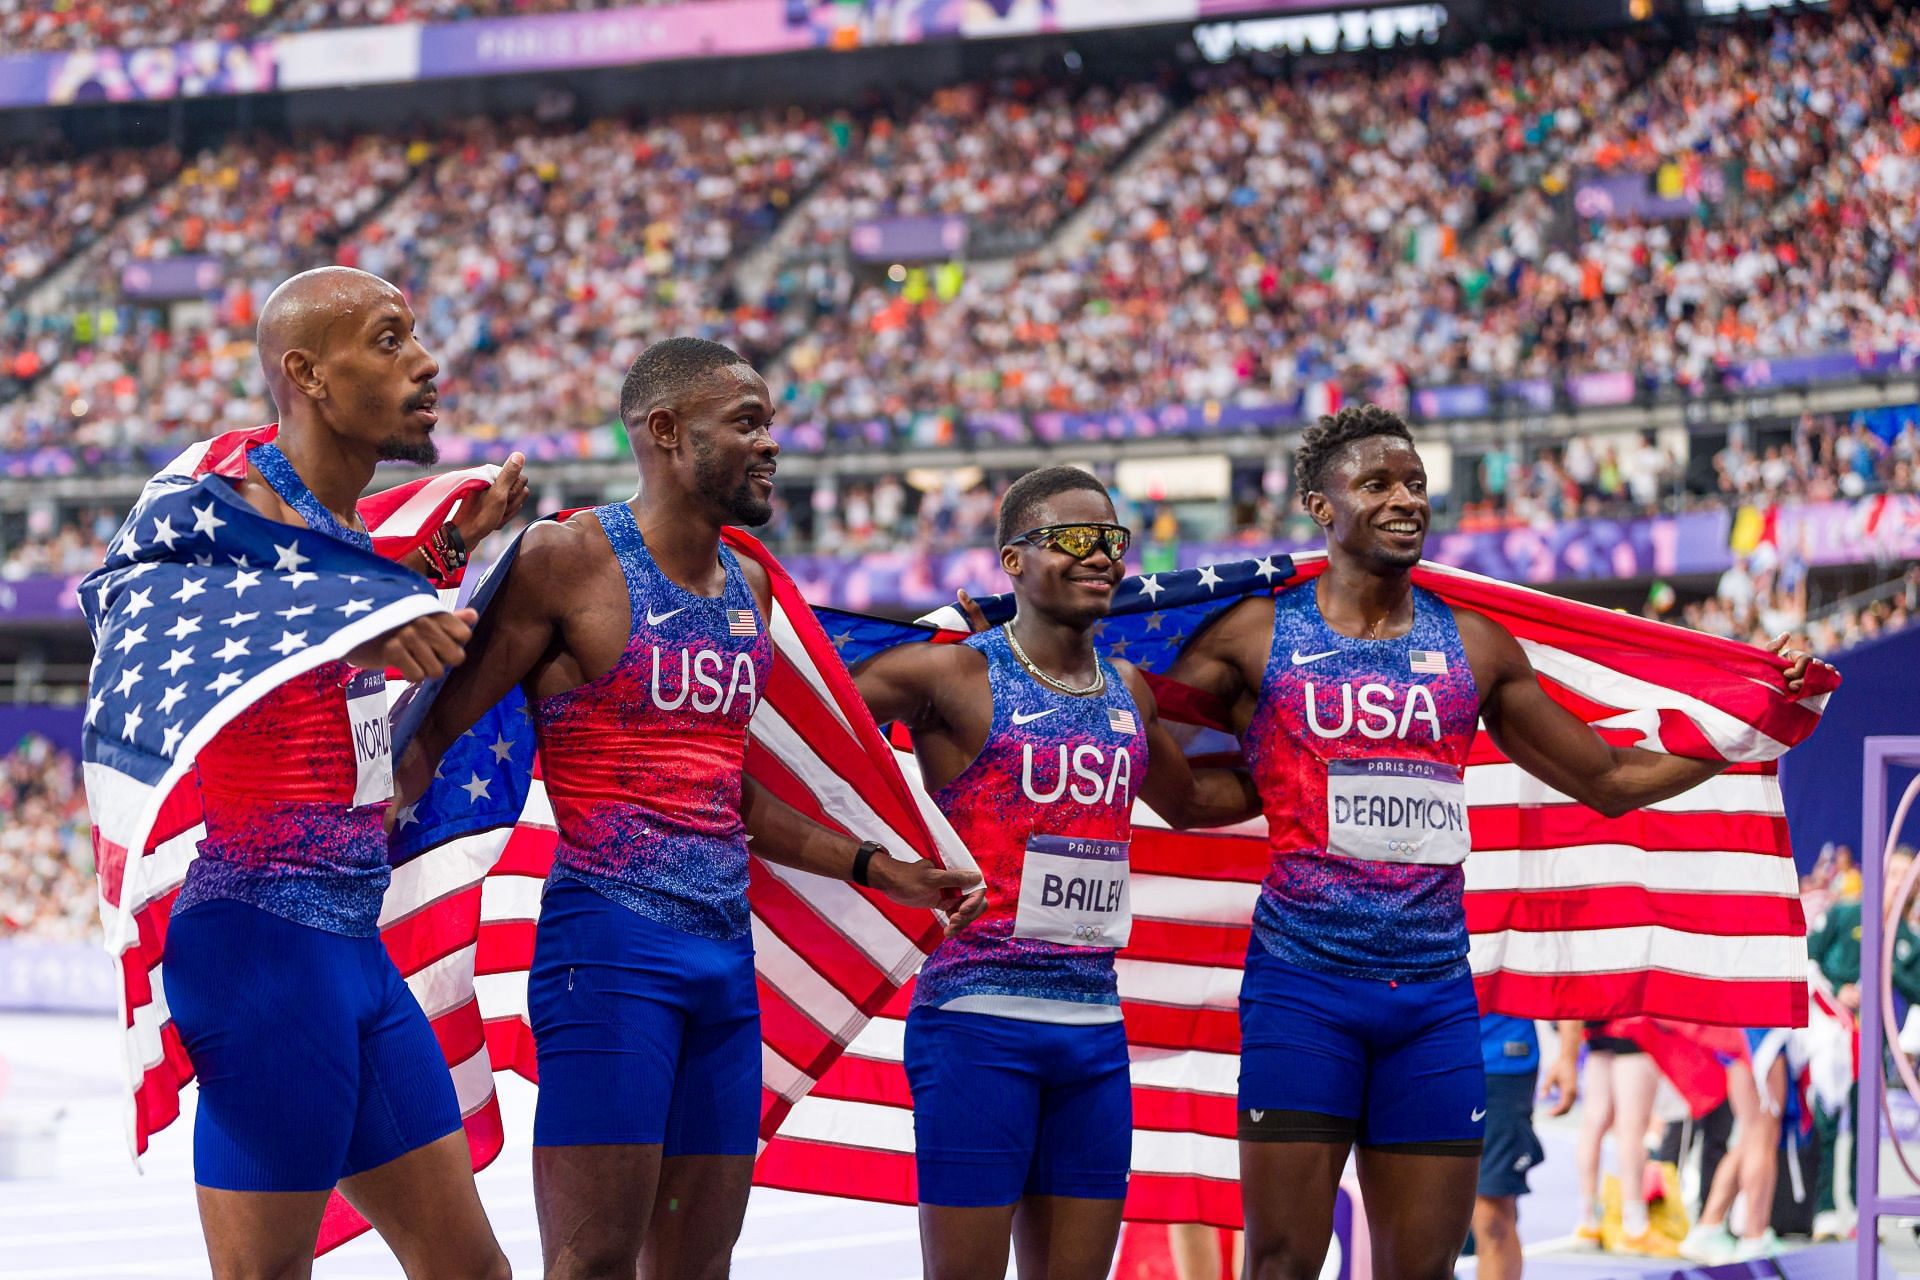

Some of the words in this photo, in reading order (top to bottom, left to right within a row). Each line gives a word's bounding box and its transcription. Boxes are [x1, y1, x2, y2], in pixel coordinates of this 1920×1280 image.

[651, 645, 756, 716] USA
[1304, 682, 1441, 742] USA
[1022, 743, 1131, 808] USA
[1367, 761, 1404, 772] PARIS
[1407, 763, 1435, 776] 2024
[1334, 795, 1463, 832] DEADMON
[1068, 842, 1101, 855] PARIS
[1041, 873, 1123, 913] BAILEY
